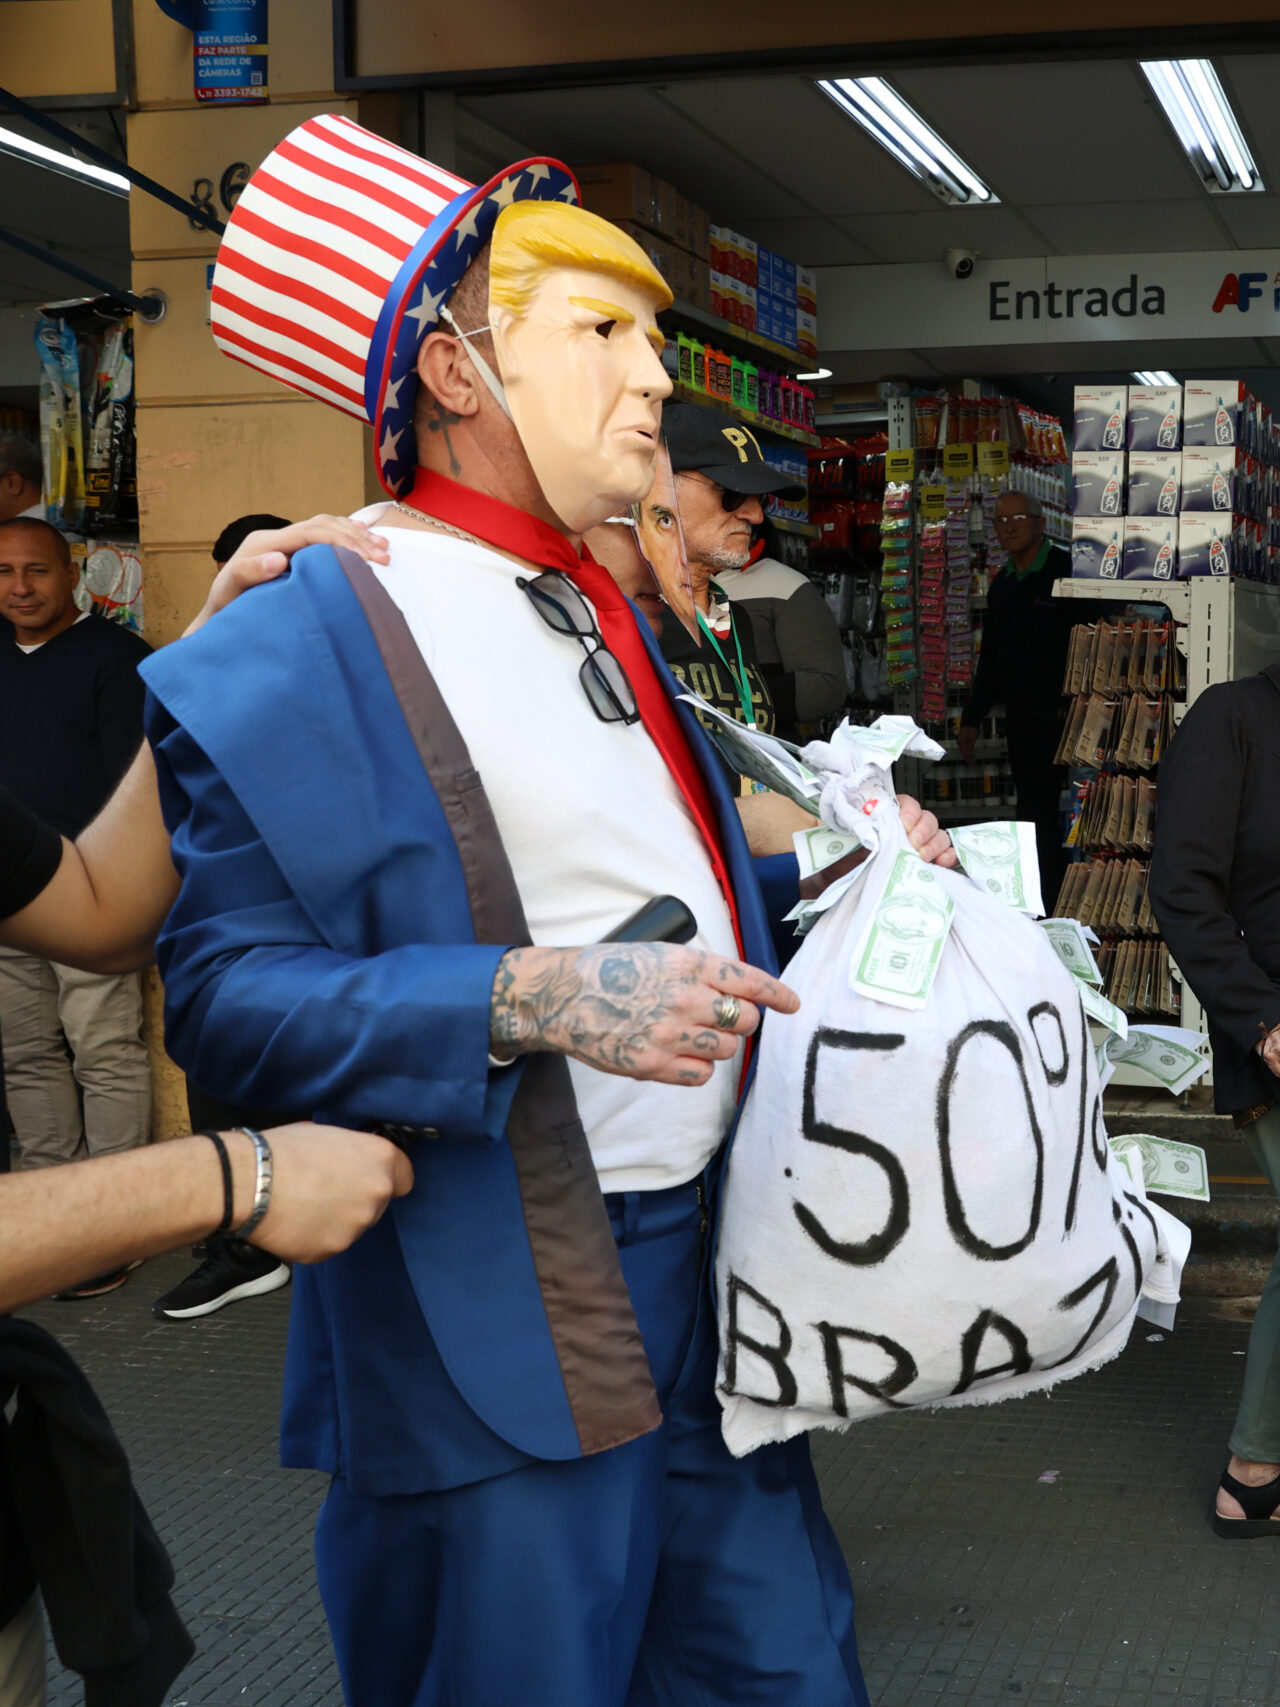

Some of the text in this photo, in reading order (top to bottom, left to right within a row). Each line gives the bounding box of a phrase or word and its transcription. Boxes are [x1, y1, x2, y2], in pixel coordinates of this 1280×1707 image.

[198, 33, 257, 44] ESTA REGIÃO
[198, 46, 246, 55] FAZ PARTE
[198, 57, 252, 66] DA REDE DE
[198, 67, 242, 77] CÂMERAS
[214, 88, 263, 97] 3393-1742
[988, 273, 1165, 322] Entrada
[1211, 271, 1269, 314] AF
[792, 989, 1108, 1268] 50%
